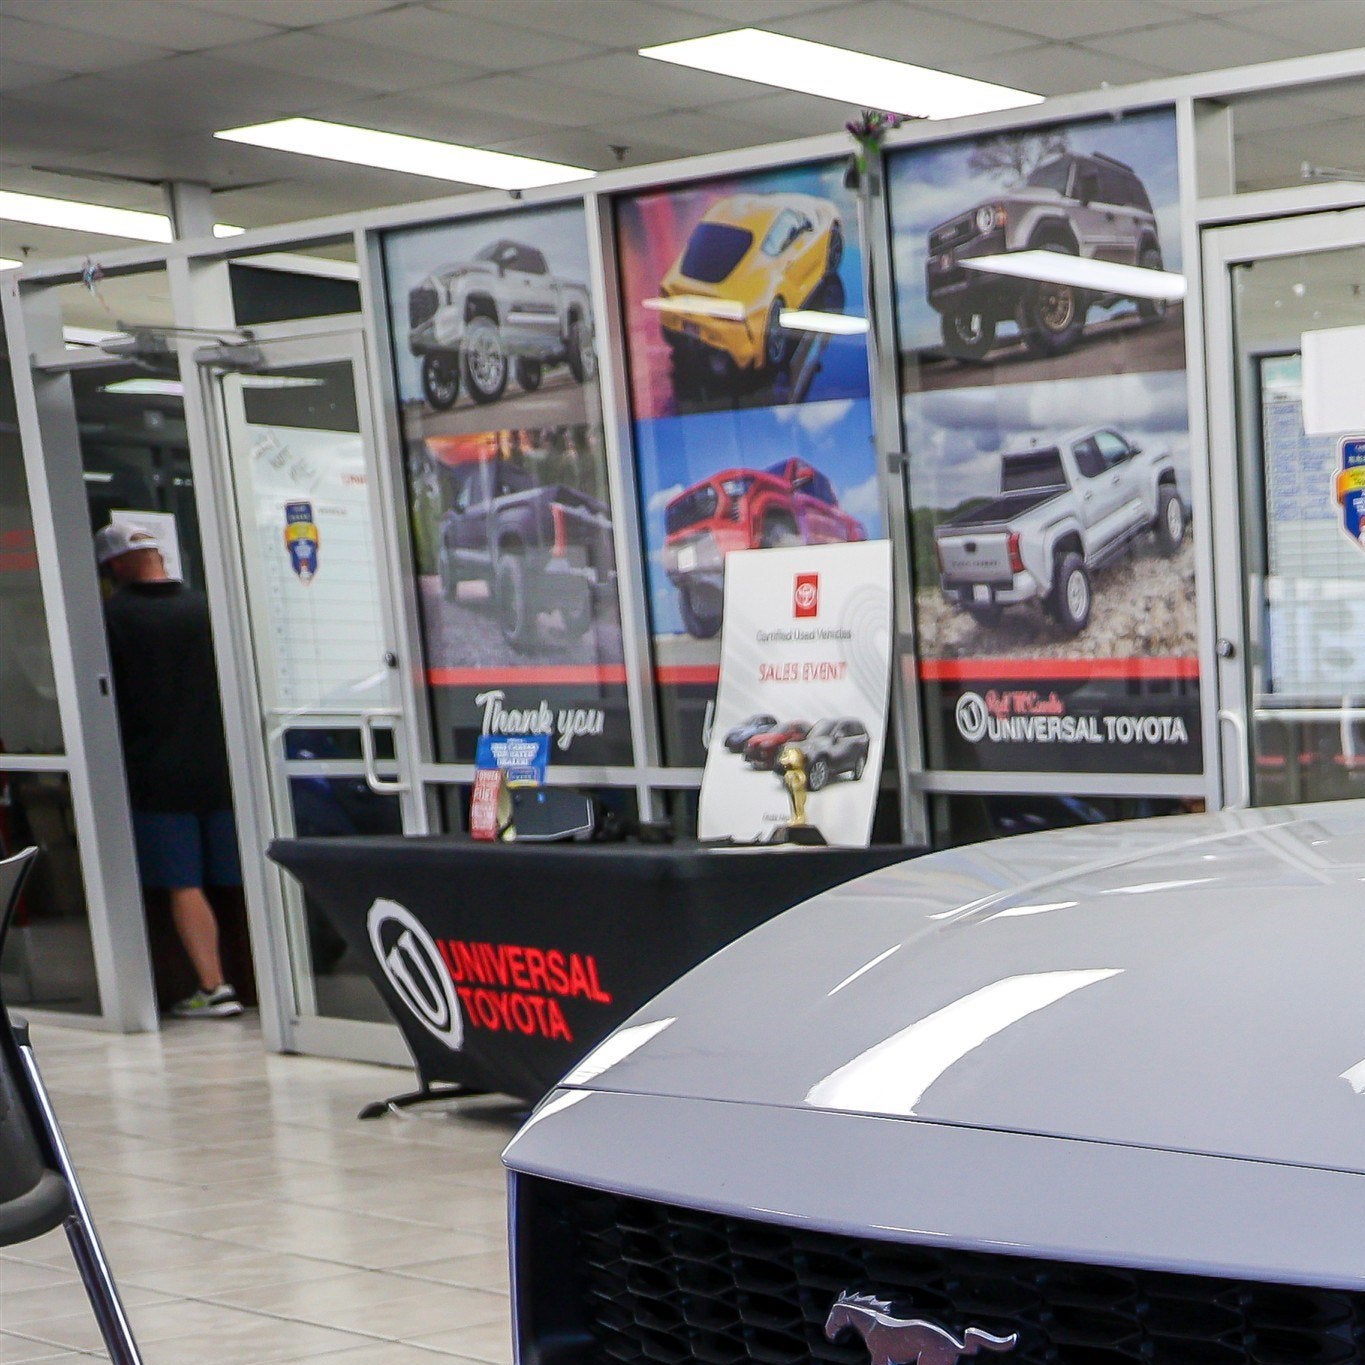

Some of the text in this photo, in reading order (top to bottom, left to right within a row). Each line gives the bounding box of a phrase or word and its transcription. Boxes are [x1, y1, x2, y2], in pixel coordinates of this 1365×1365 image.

[794, 629, 815, 640] Used
[759, 662, 846, 681] SALES EVENT
[475, 690, 605, 751] Thank you
[988, 716, 1104, 743] UNIVERSAL
[1103, 716, 1189, 744] TOYOTA
[435, 939, 613, 1004] UNIVERSAL
[457, 986, 574, 1042] TOYOTA
